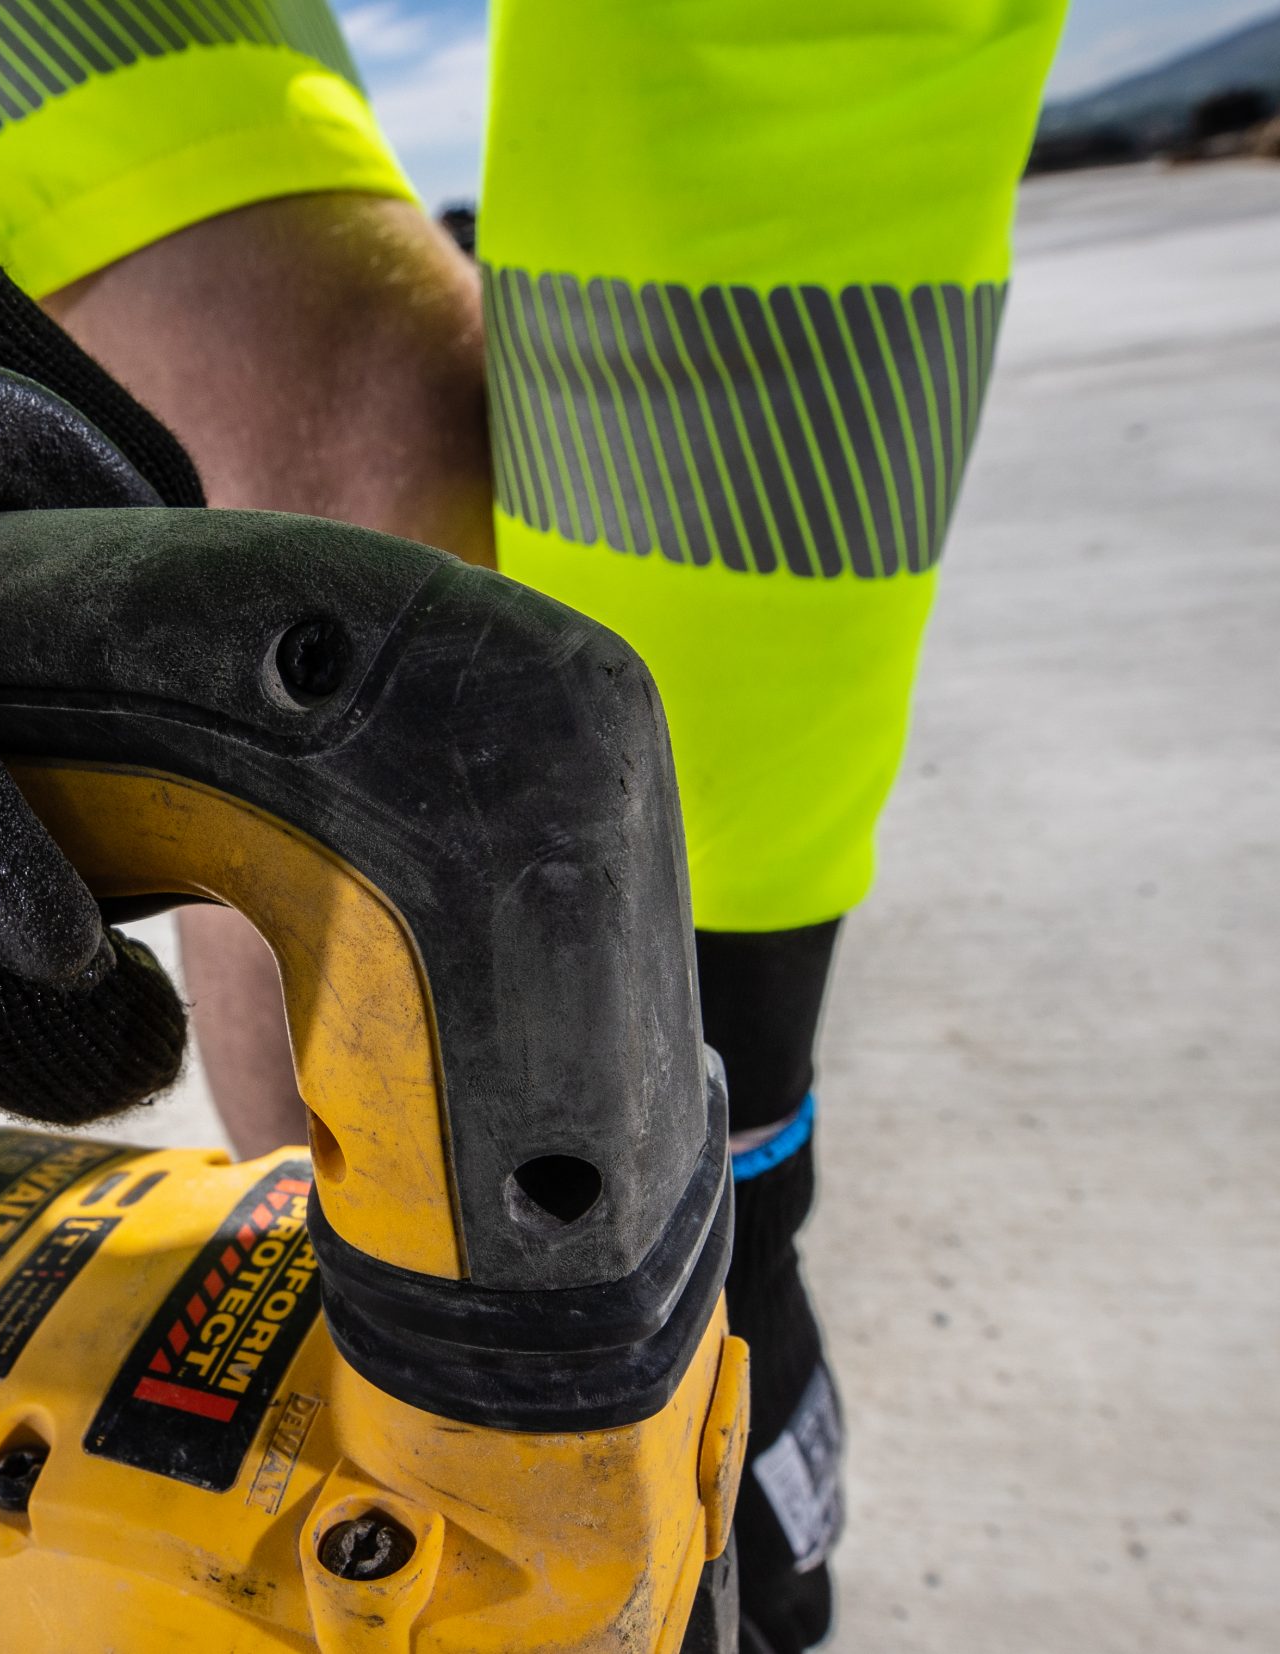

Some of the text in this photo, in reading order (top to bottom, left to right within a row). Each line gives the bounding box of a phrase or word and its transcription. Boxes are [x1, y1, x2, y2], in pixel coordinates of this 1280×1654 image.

[186, 1196, 307, 1377] PROTECT
[219, 1242, 319, 1394] RFORM
[252, 1393, 318, 1514] DEWALT
